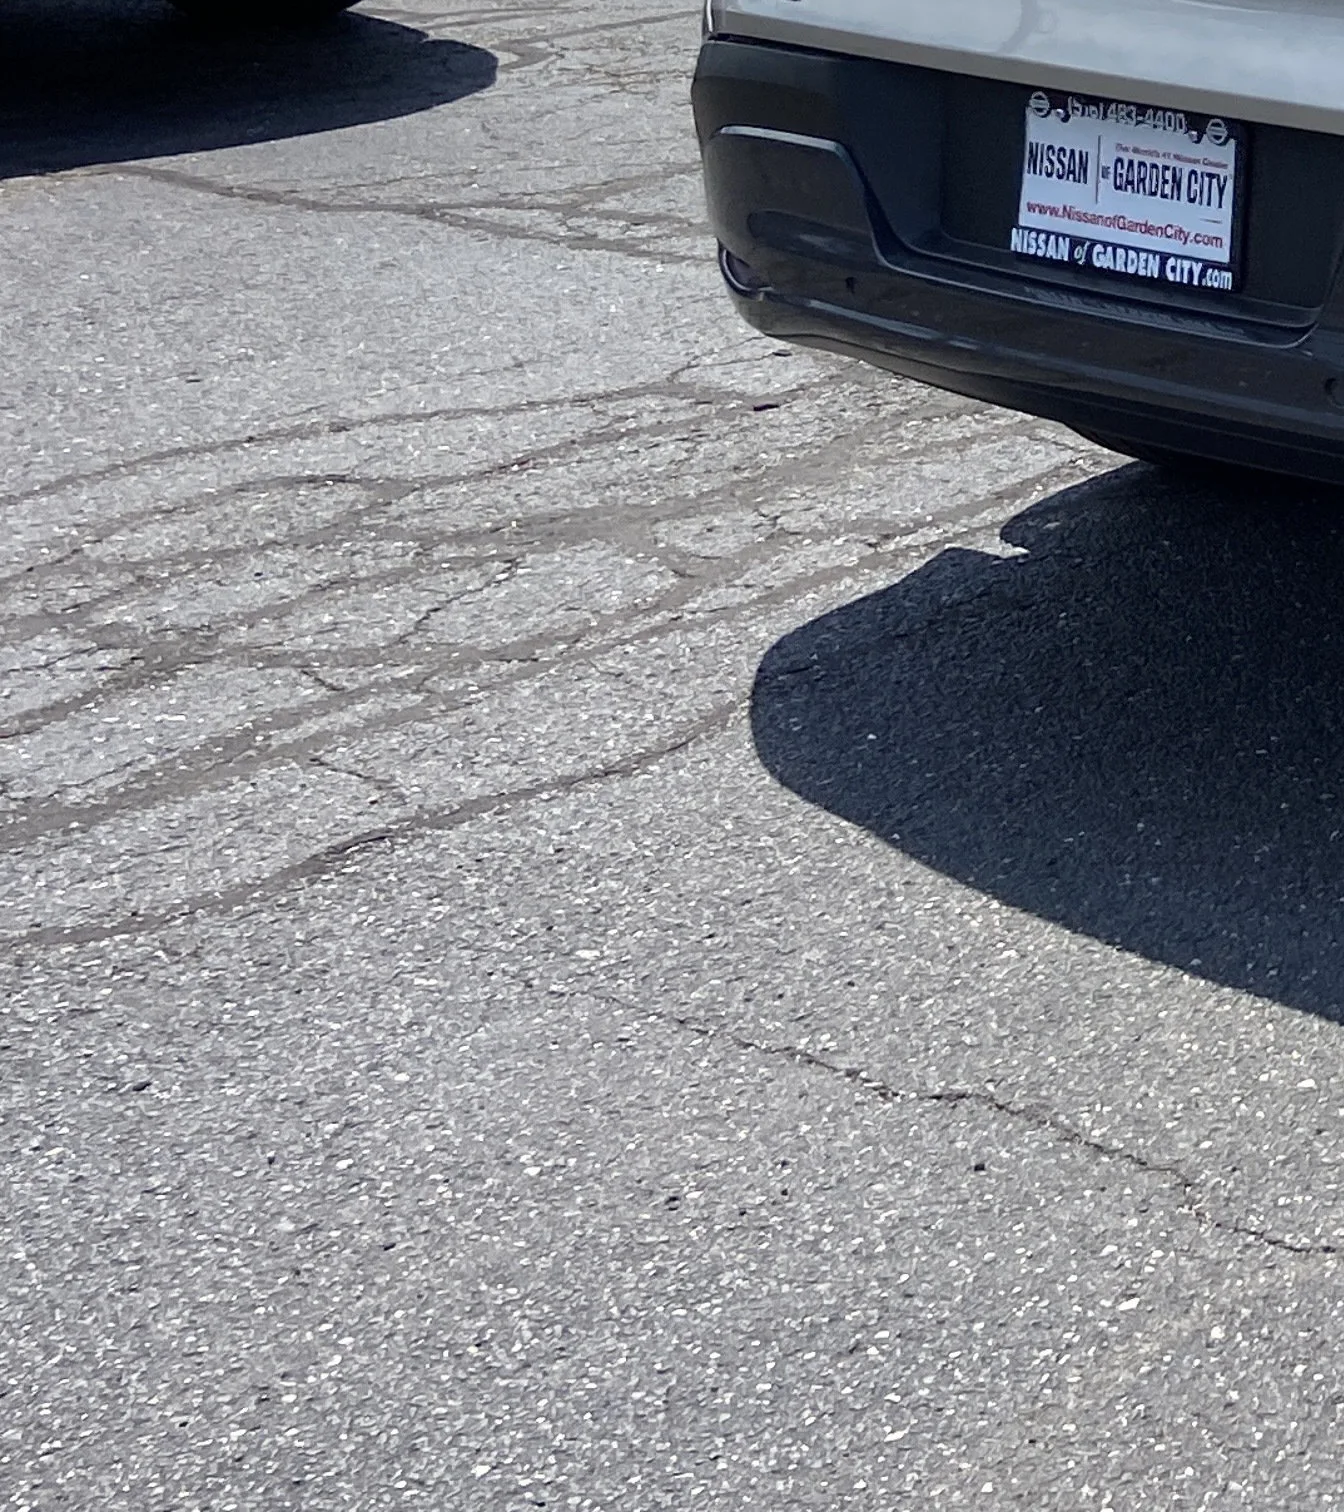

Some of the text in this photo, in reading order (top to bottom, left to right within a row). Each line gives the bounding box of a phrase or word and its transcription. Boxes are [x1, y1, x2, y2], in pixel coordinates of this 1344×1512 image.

[1026, 141, 1089, 185] NISSAN
[1112, 157, 1182, 203] GARDEN
[1186, 169, 1228, 209] CITY
[1026, 199, 1224, 249] www.NissanofGardenCity.com
[1010, 227, 1233, 291] NISSAN of GARDEN CITY.com
